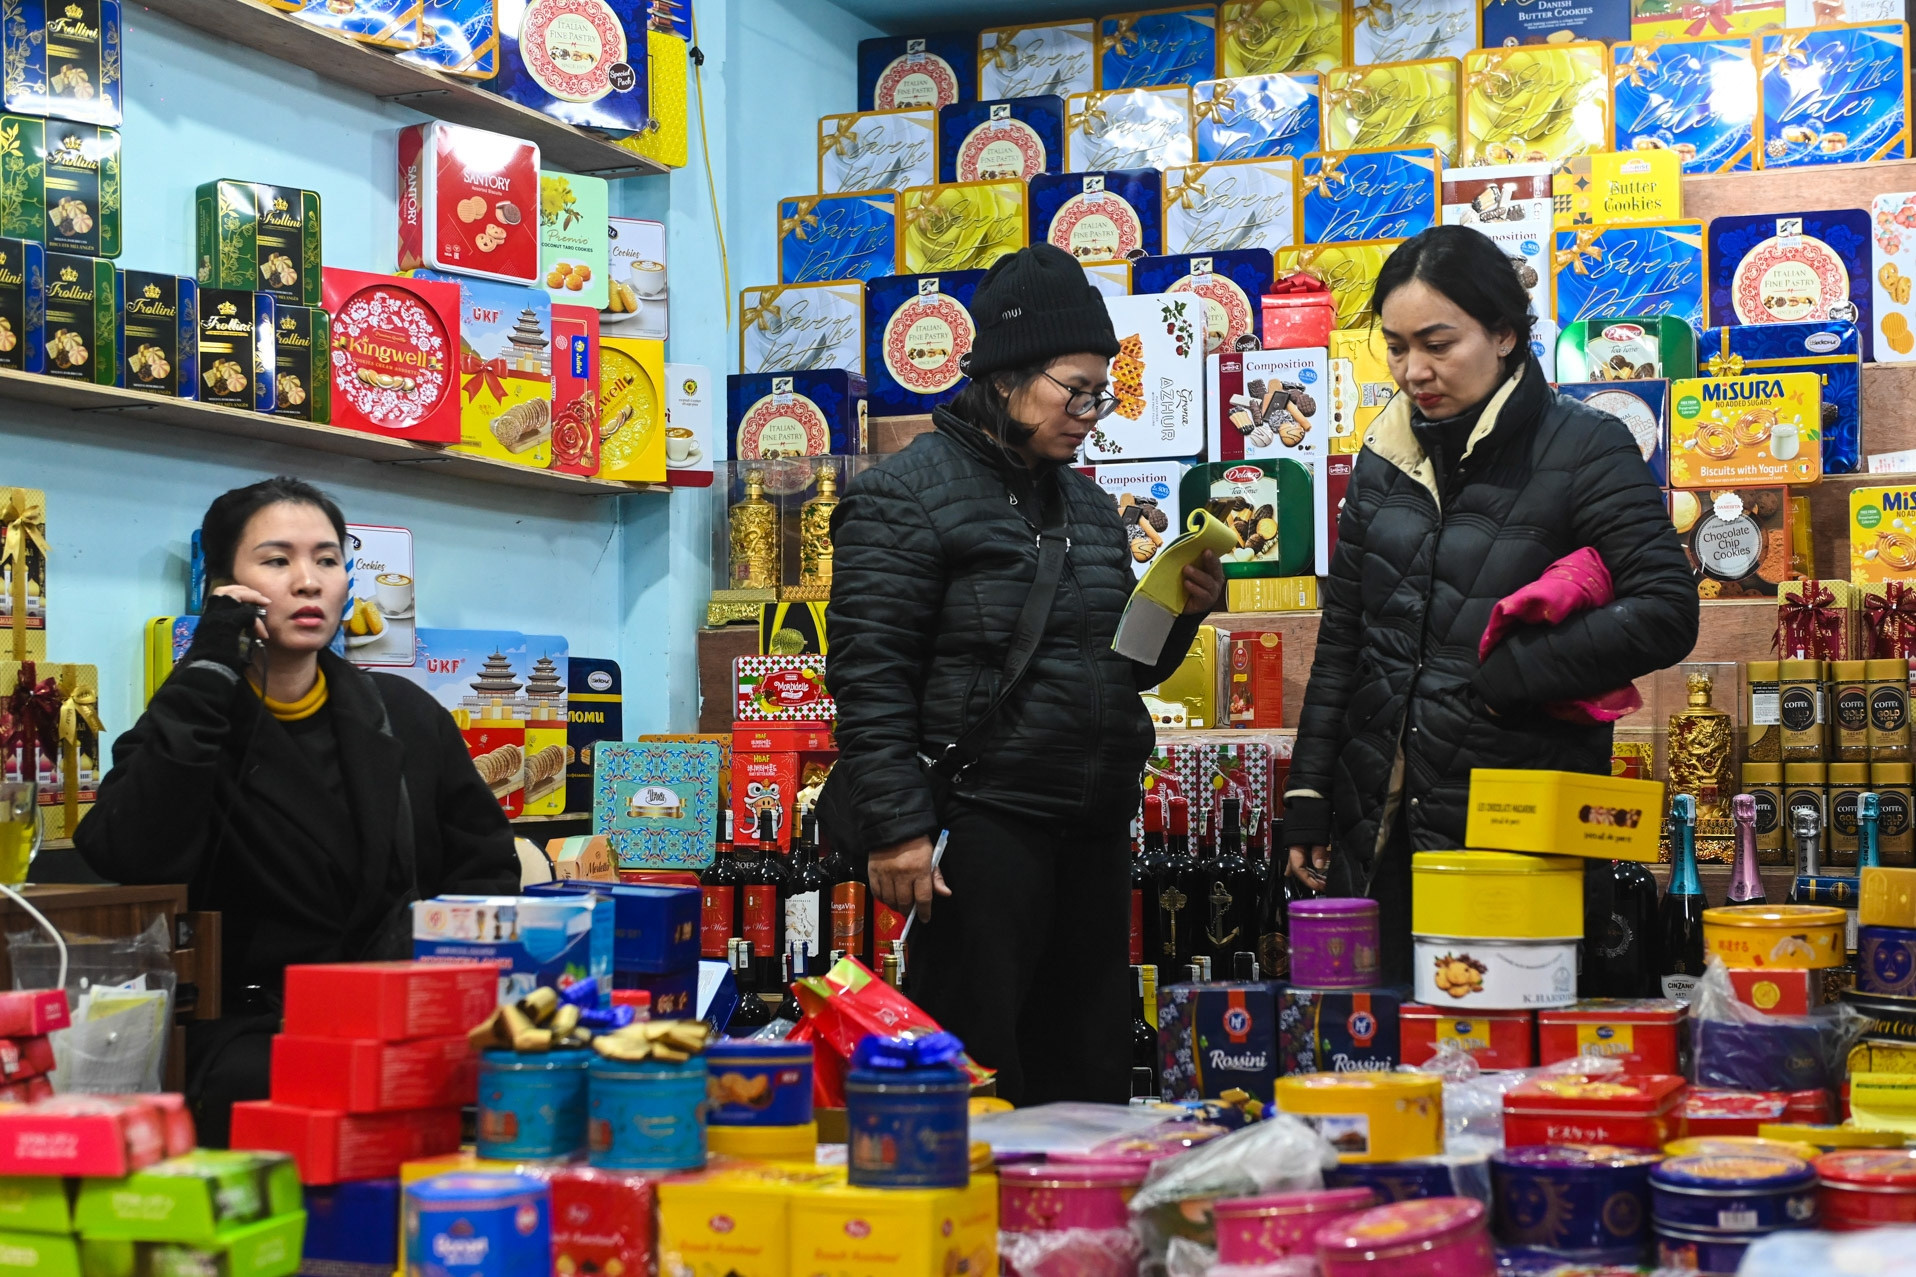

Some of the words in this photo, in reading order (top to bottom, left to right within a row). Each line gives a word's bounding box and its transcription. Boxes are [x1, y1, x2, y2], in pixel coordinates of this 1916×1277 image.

[1538, 1, 1572, 10] DANISH
[1518, 11, 1553, 21] BUTTER
[1554, 7, 1593, 17] COOKIES
[47, 17, 98, 39] Frollini
[557, 20, 588, 31] ITALIAN
[550, 30, 567, 39] FINE
[569, 32, 597, 43] PASTRY
[609, 69, 630, 78] Special
[617, 77, 632, 86] Pack
[851, 126, 907, 155] Save
[996, 155, 1019, 163] PASTRY
[463, 172, 511, 191] SANTORY
[1335, 164, 1400, 201] Save
[1610, 180, 1657, 196] Butter
[408, 166, 417, 225] SANTORY
[1198, 177, 1264, 212] Save
[1604, 196, 1662, 213] Cookies
[259, 208, 302, 229] Frollini
[809, 209, 863, 242] Save
[1081, 222, 1107, 230] ITALIAN
[547, 229, 589, 245] Premio
[1074, 231, 1089, 239] FINE
[1090, 230, 1115, 238] PASTRY
[613, 246, 641, 259] Cookies
[1591, 240, 1666, 278] Save
[1773, 270, 1806, 278] ITALIAN
[1785, 279, 1815, 287] PASTRY
[46, 281, 94, 301] Frollini
[127, 298, 176, 316] Frollini
[200, 314, 252, 333] Frollini
[771, 300, 832, 333] Save
[916, 324, 942, 332] ITALIAN
[925, 332, 949, 341] PASTRY
[349, 336, 427, 368] Kingwell
[575, 352, 583, 374] Julie's
[1246, 359, 1315, 373] Composition
[1160, 376, 1175, 441] AZHUR
[1726, 400, 1746, 408] ADDED
[1747, 399, 1772, 407] SUGARS
[769, 424, 796, 432] ITALIAN
[778, 433, 803, 441] PASTRY
[1700, 466, 1736, 477] Biscuits
[1737, 465, 1758, 475] with
[1759, 464, 1788, 476] Yogurt
[1099, 473, 1167, 487] Composition
[1703, 526, 1750, 543] Chocolate
[1718, 539, 1740, 550] Chip
[1713, 546, 1751, 561] Cookies
[355, 558, 386, 572] Cookies
[1877, 709, 1900, 718] GOLD
[1839, 814, 1858, 822] GOL
[1667, 982, 1695, 990] CINZANO
[1209, 1049, 1268, 1071] Rossini
[1333, 1053, 1392, 1073] Rossini
